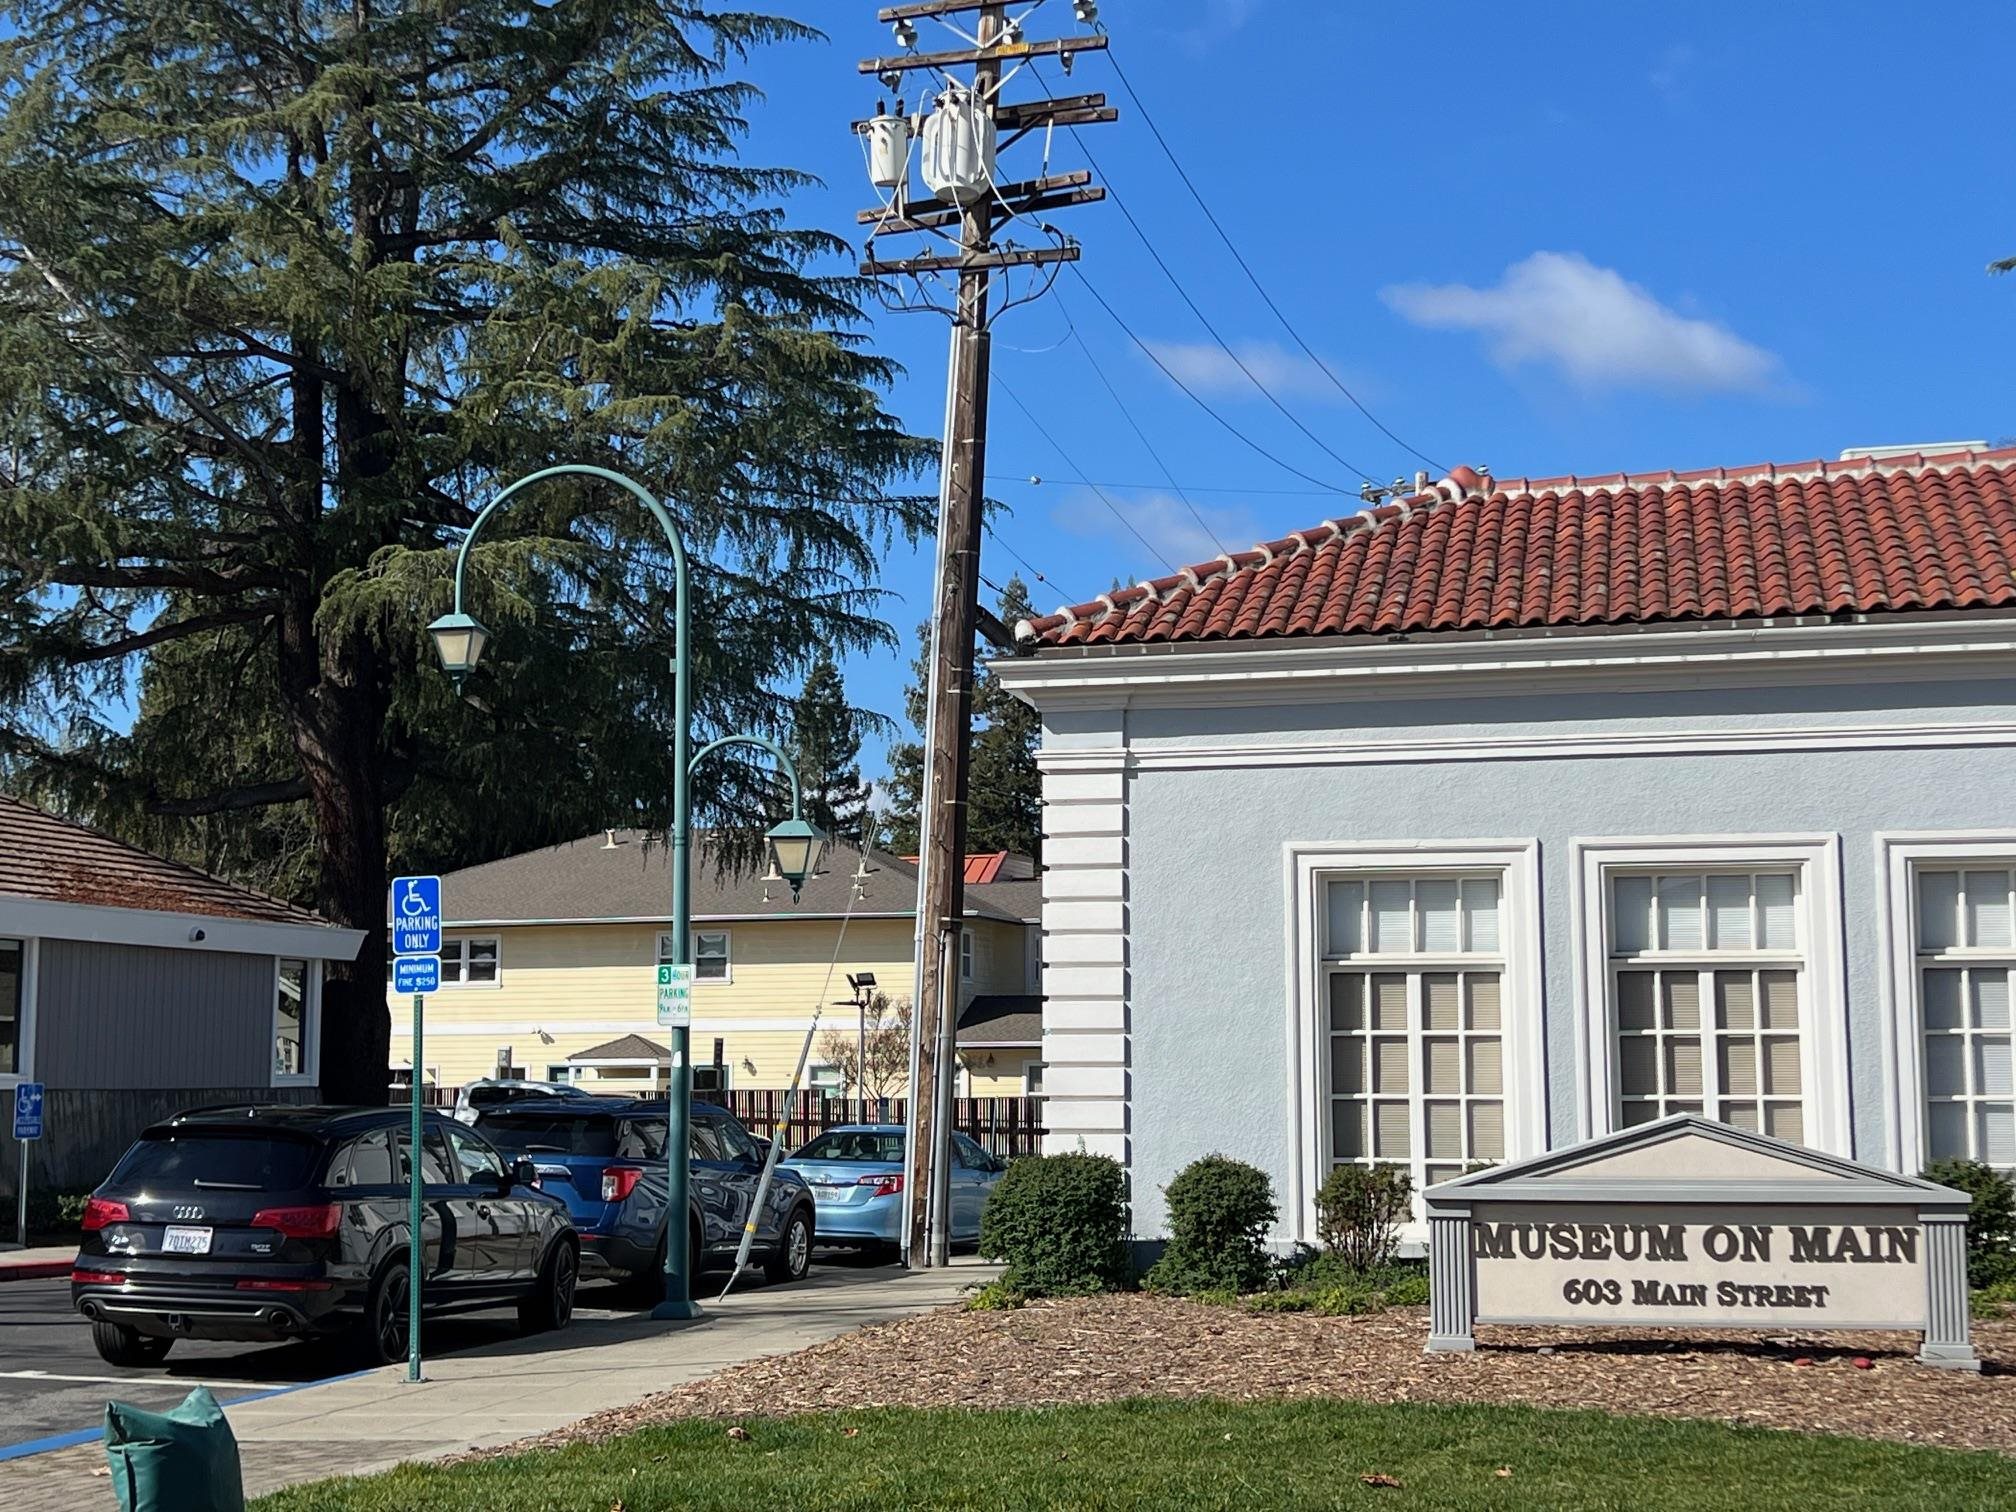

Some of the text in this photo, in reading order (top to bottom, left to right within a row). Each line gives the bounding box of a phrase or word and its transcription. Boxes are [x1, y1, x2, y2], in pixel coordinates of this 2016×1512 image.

[395, 915, 438, 932] PARKING
[404, 933, 430, 949] ONLY
[400, 964, 434, 975] MINIMUM
[661, 968, 669, 983] 3
[398, 976, 436, 987] FINE $250
[660, 987, 688, 1000] PARKING
[1474, 1223, 1920, 1264] MUSEUM ON MAIN
[1563, 1278, 1622, 1305] 603
